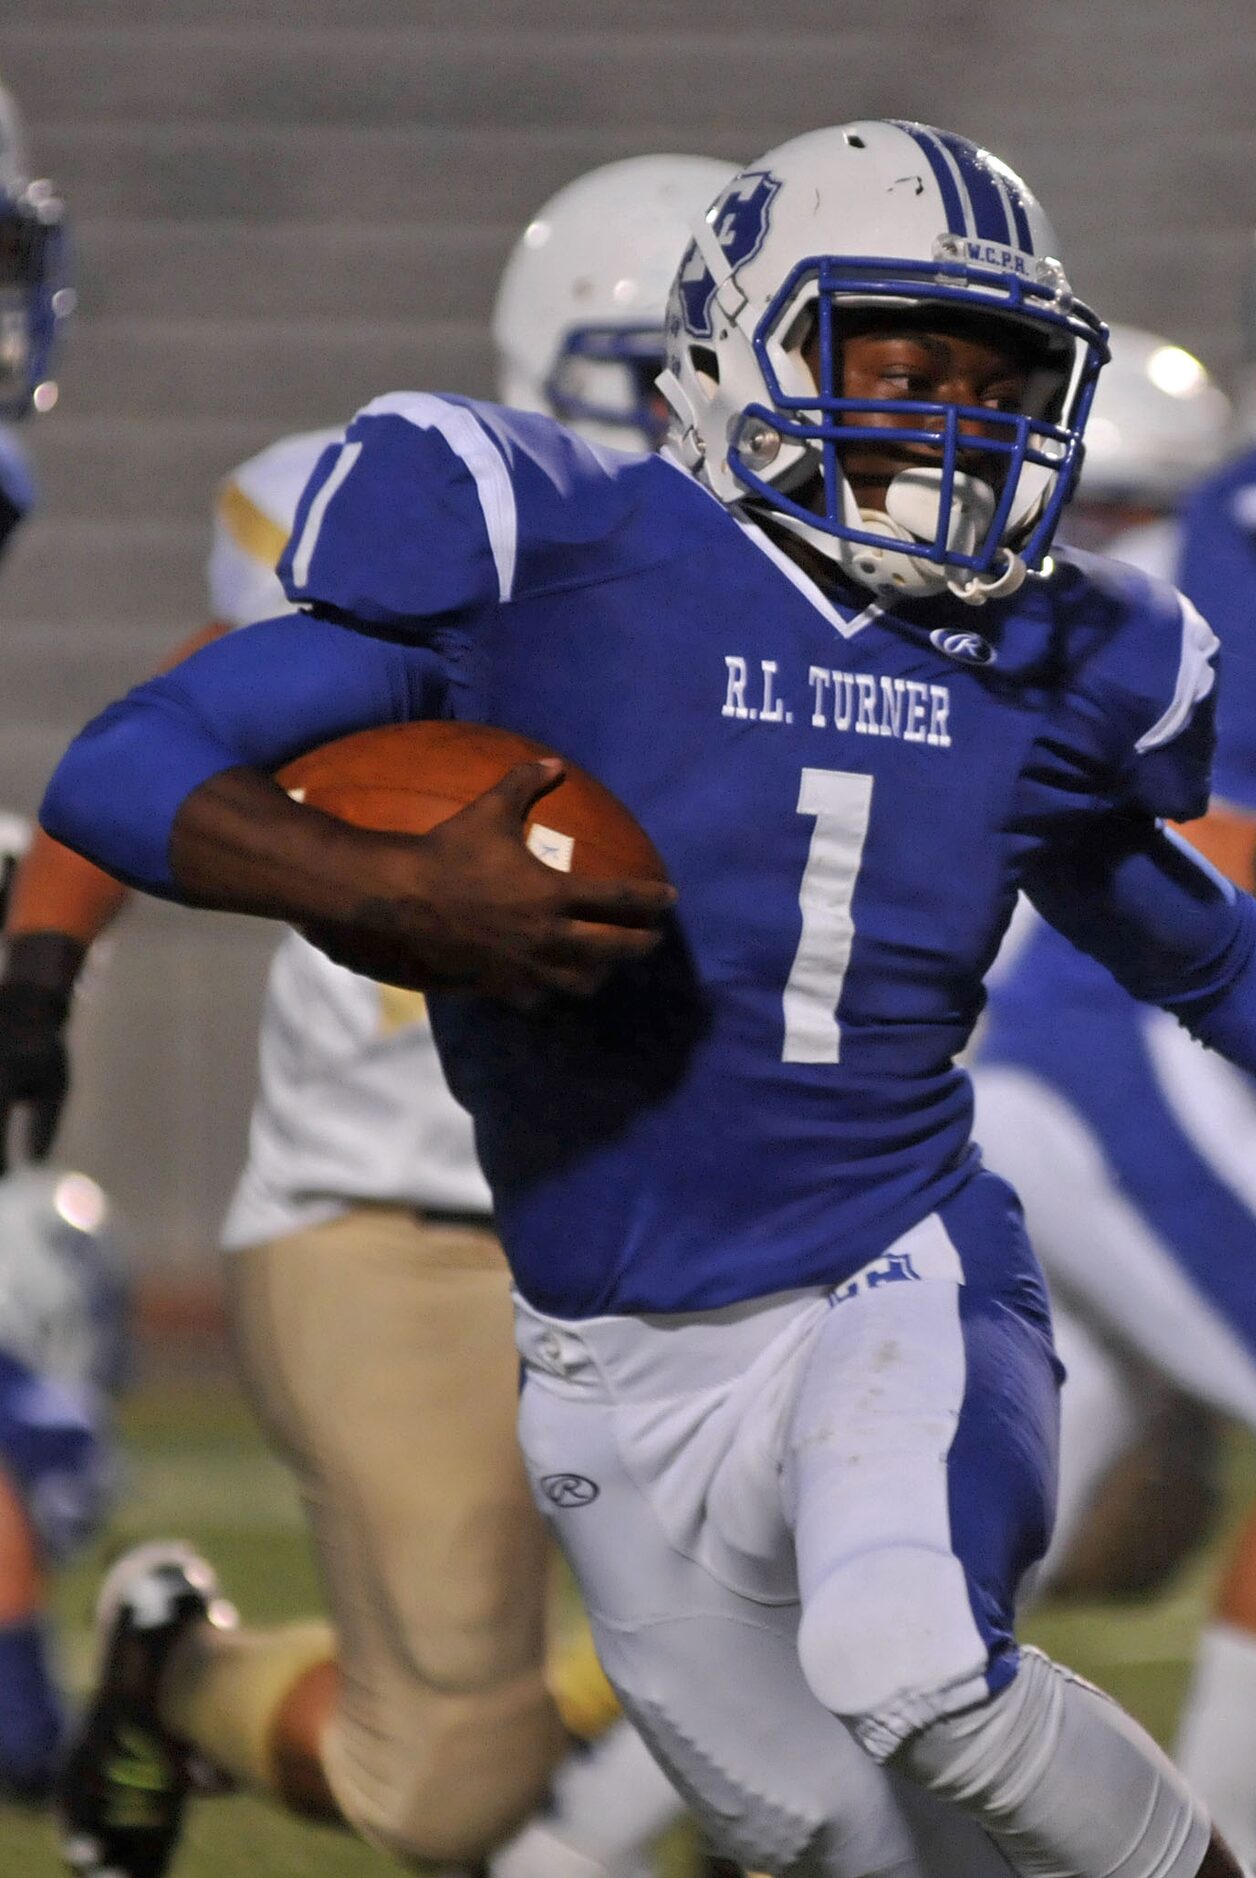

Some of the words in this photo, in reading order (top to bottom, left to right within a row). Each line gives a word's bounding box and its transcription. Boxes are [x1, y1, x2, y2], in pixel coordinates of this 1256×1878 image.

[721, 655, 794, 724] R.L.
[808, 665, 952, 748] TURNER
[781, 767, 874, 1065] 1
